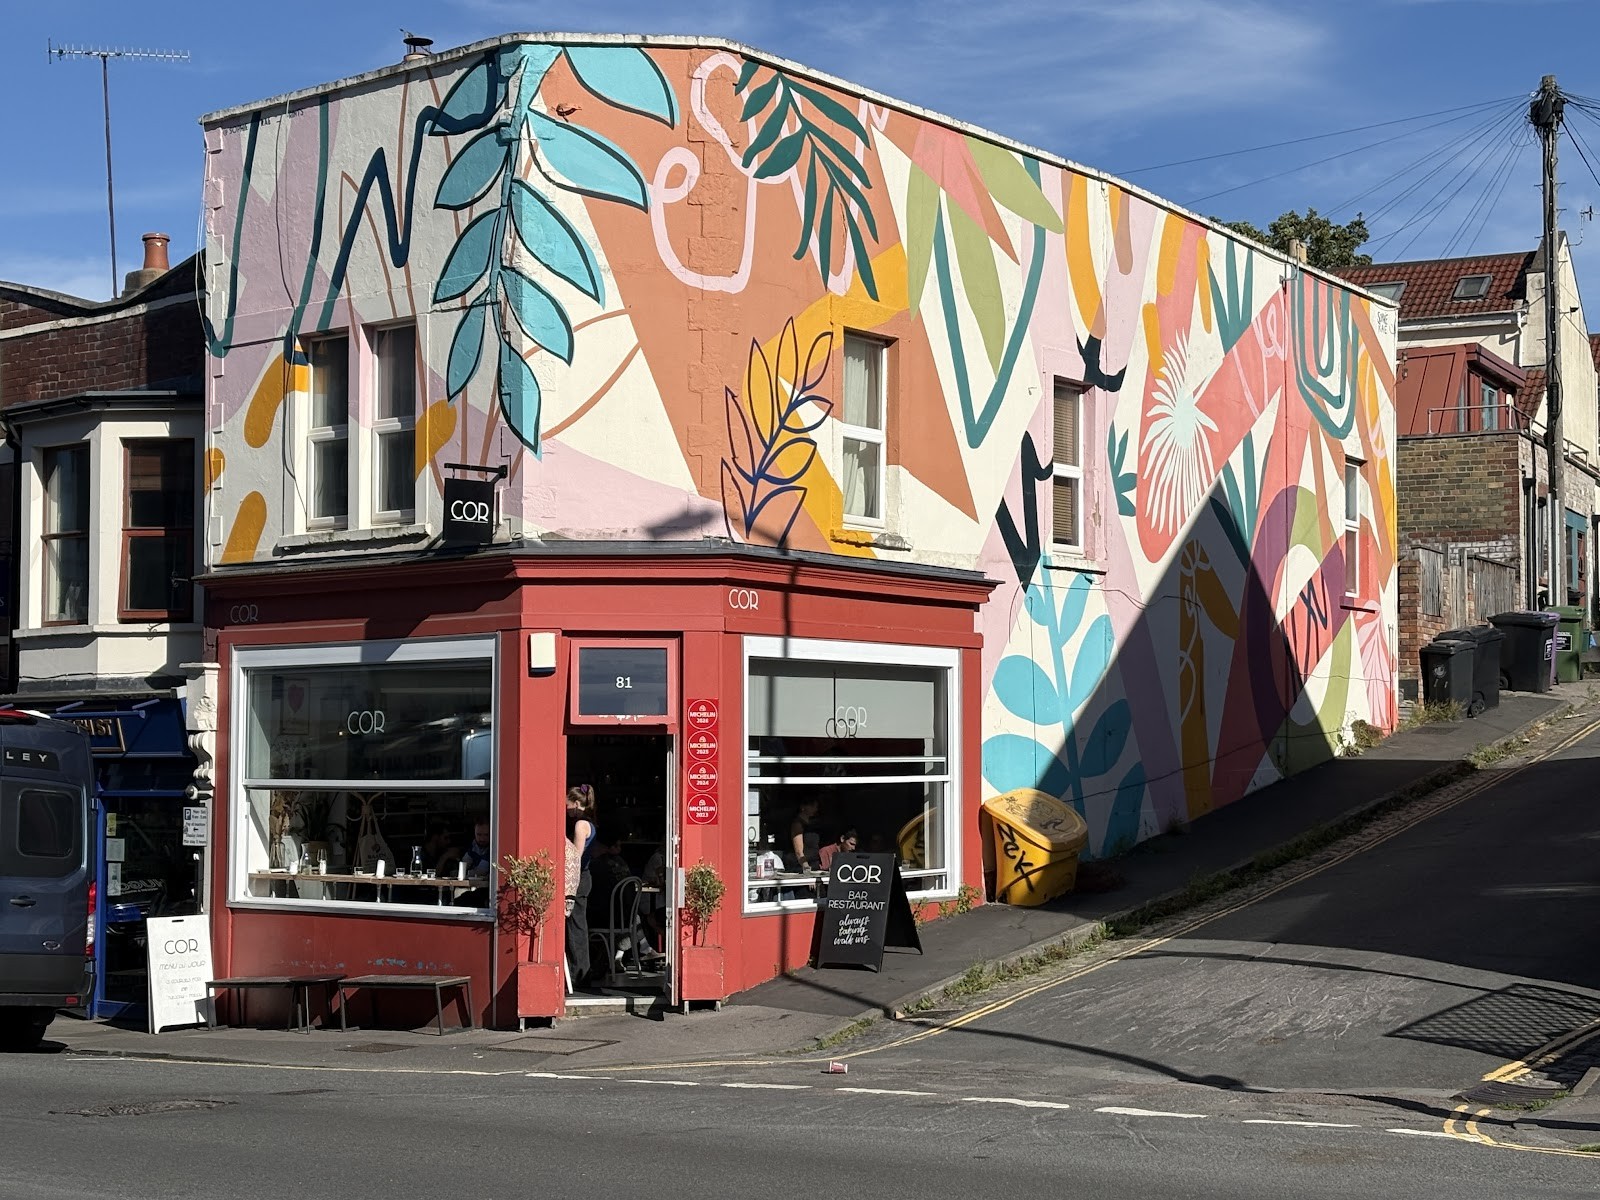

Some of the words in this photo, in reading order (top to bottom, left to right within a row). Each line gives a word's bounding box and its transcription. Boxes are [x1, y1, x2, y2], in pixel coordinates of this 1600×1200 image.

[450, 499, 489, 522] COR
[728, 588, 759, 610] COR
[230, 604, 259, 623] COR
[615, 676, 633, 689] 81
[347, 710, 386, 735] COR
[835, 705, 867, 728] COR
[837, 864, 882, 883] COR
[848, 890, 869, 901] BAR
[828, 899, 886, 911] RESTAURANT
[838, 913, 870, 928] always
[838, 925, 868, 937] taking
[164, 938, 199, 955] COR
